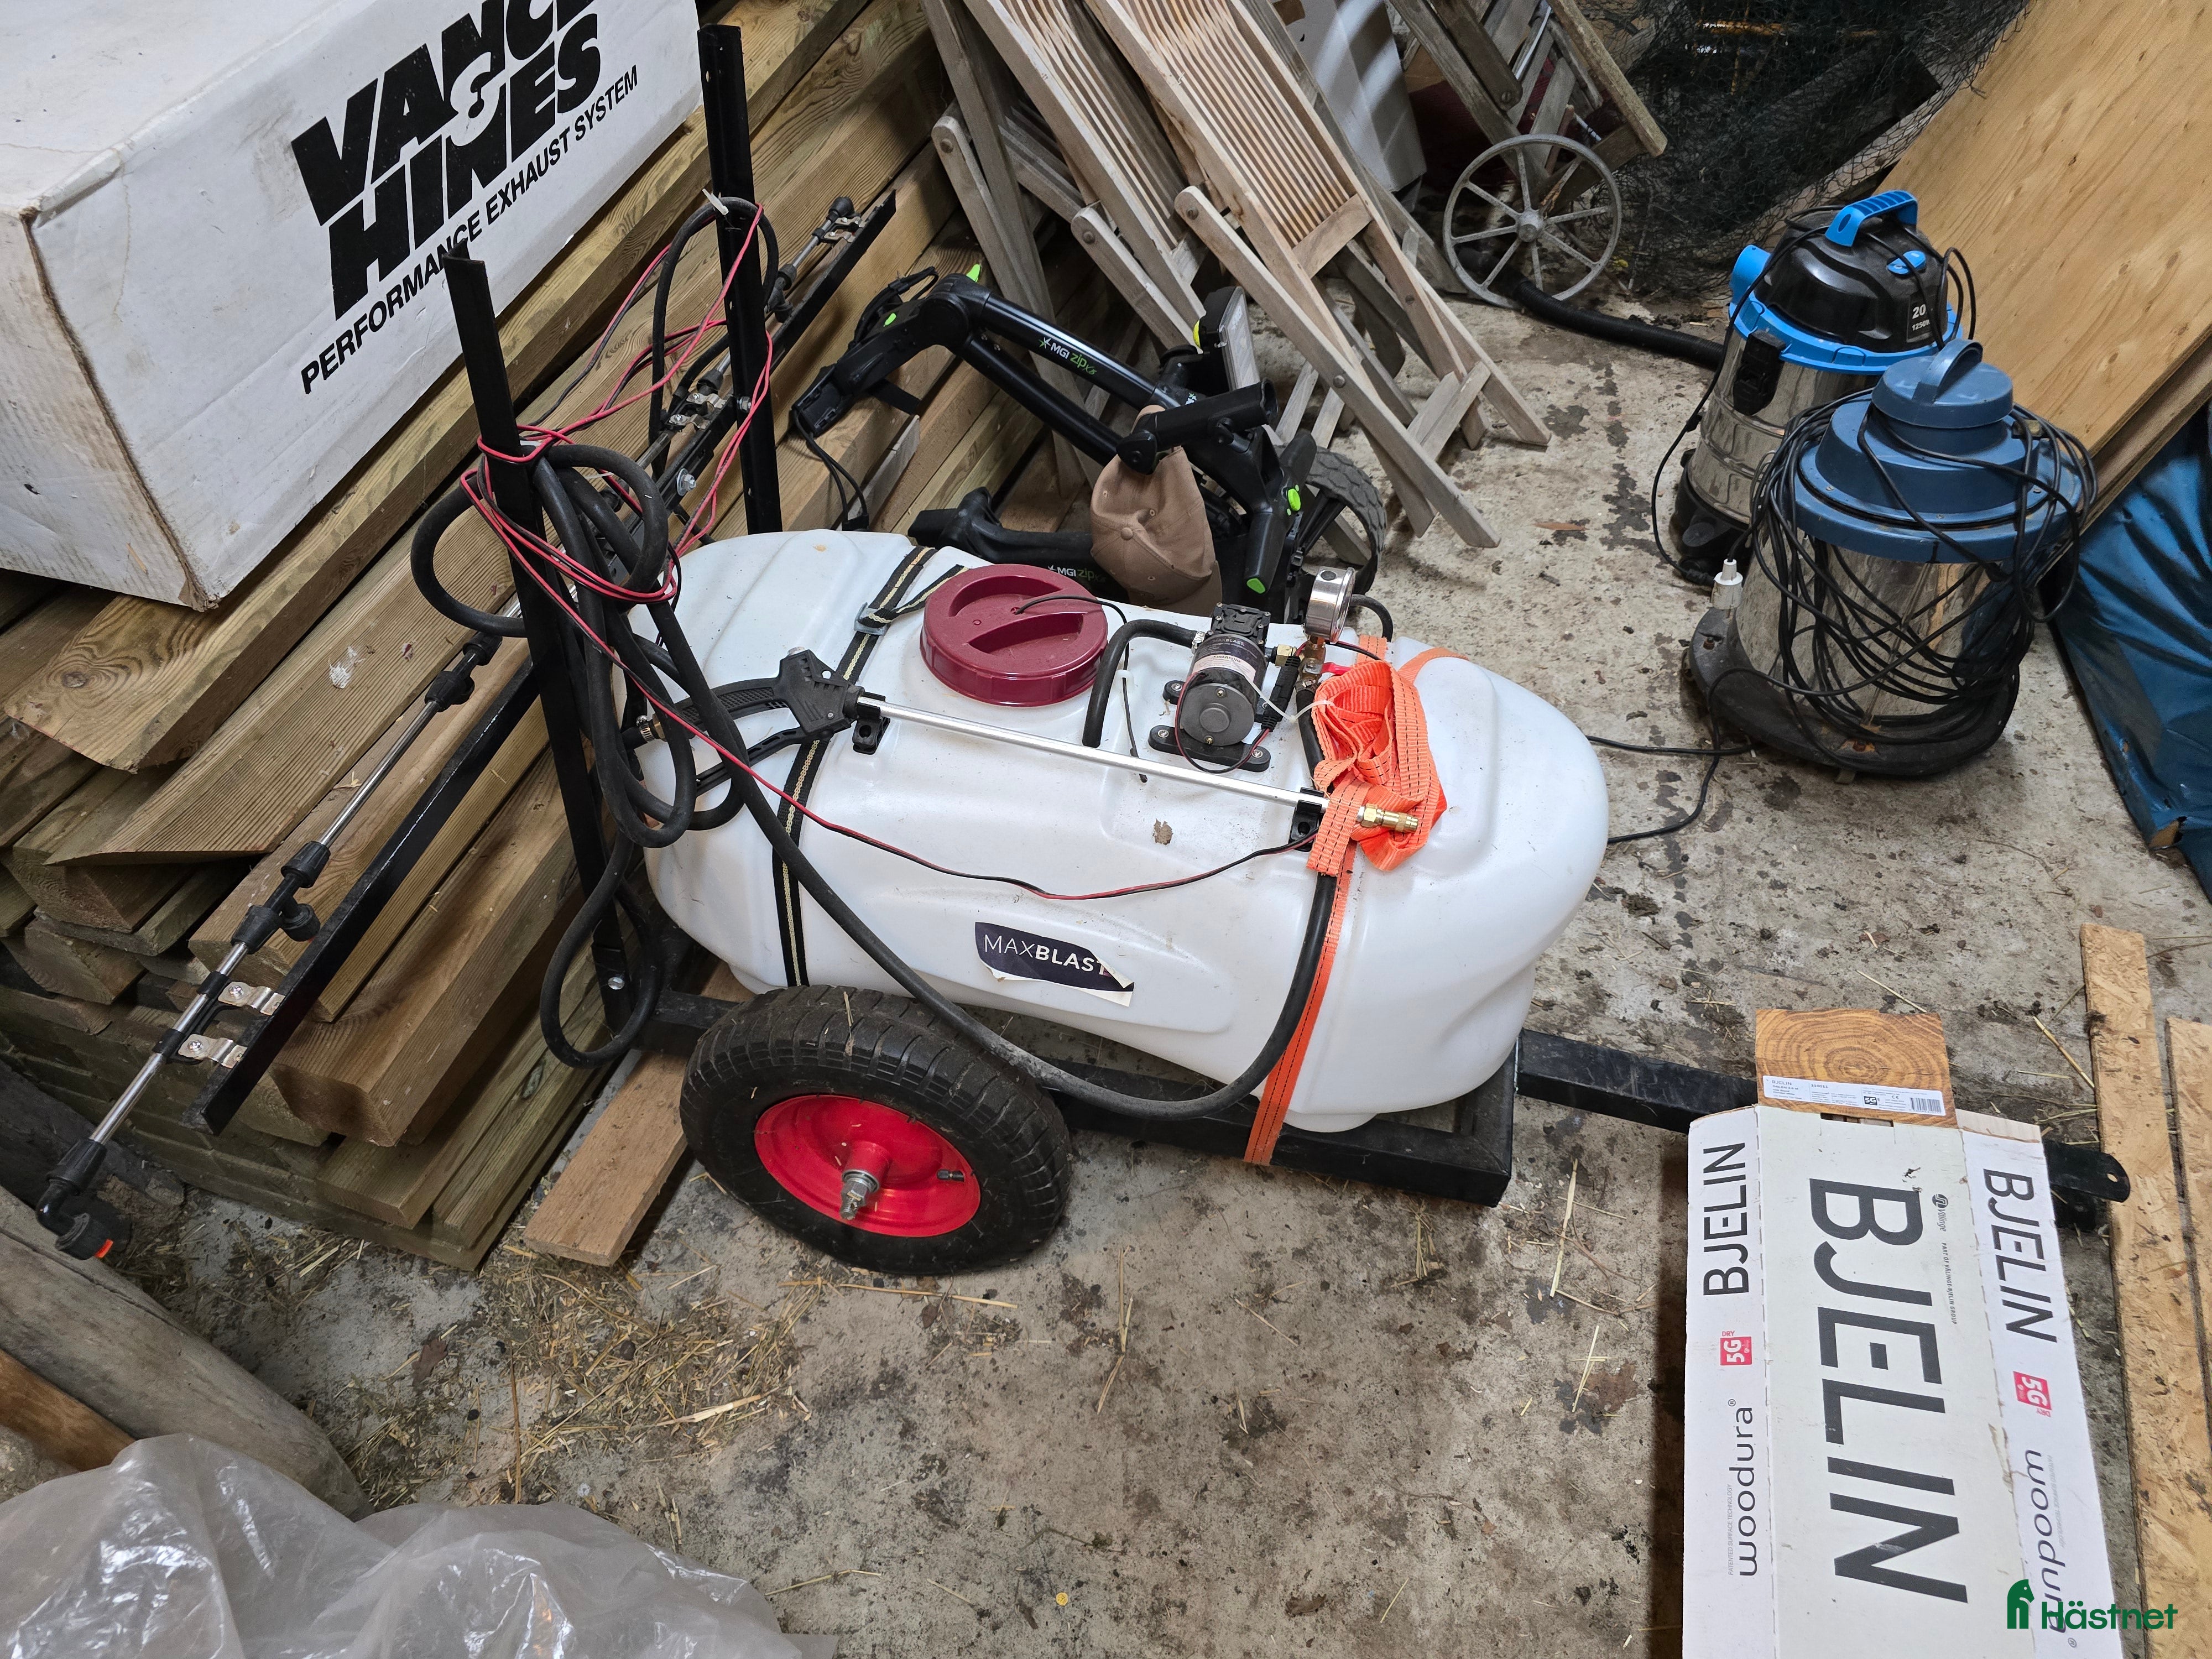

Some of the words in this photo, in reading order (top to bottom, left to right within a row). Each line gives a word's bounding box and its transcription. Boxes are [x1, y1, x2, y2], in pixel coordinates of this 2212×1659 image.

[291, 0, 594, 226] VANC
[451, 52, 501, 146] &
[486, 126, 570, 225] EXHAUST
[575, 65, 637, 141] SYSTEM
[329, 13, 601, 320] HINES
[1051, 343, 1070, 359] MGI
[1057, 567, 1076, 577] MGI
[985, 934, 1105, 975] MAXBLAST
[1704, 1143, 1749, 1295] BJELIN
[1937, 1209, 1947, 1232] Välinge
[1983, 1168, 2057, 1343] BJELIN
[1724, 1340, 1745, 1363] 5G
[1809, 1178, 1968, 1603] BJELIN
[2022, 1376, 2048, 1406] 5G
